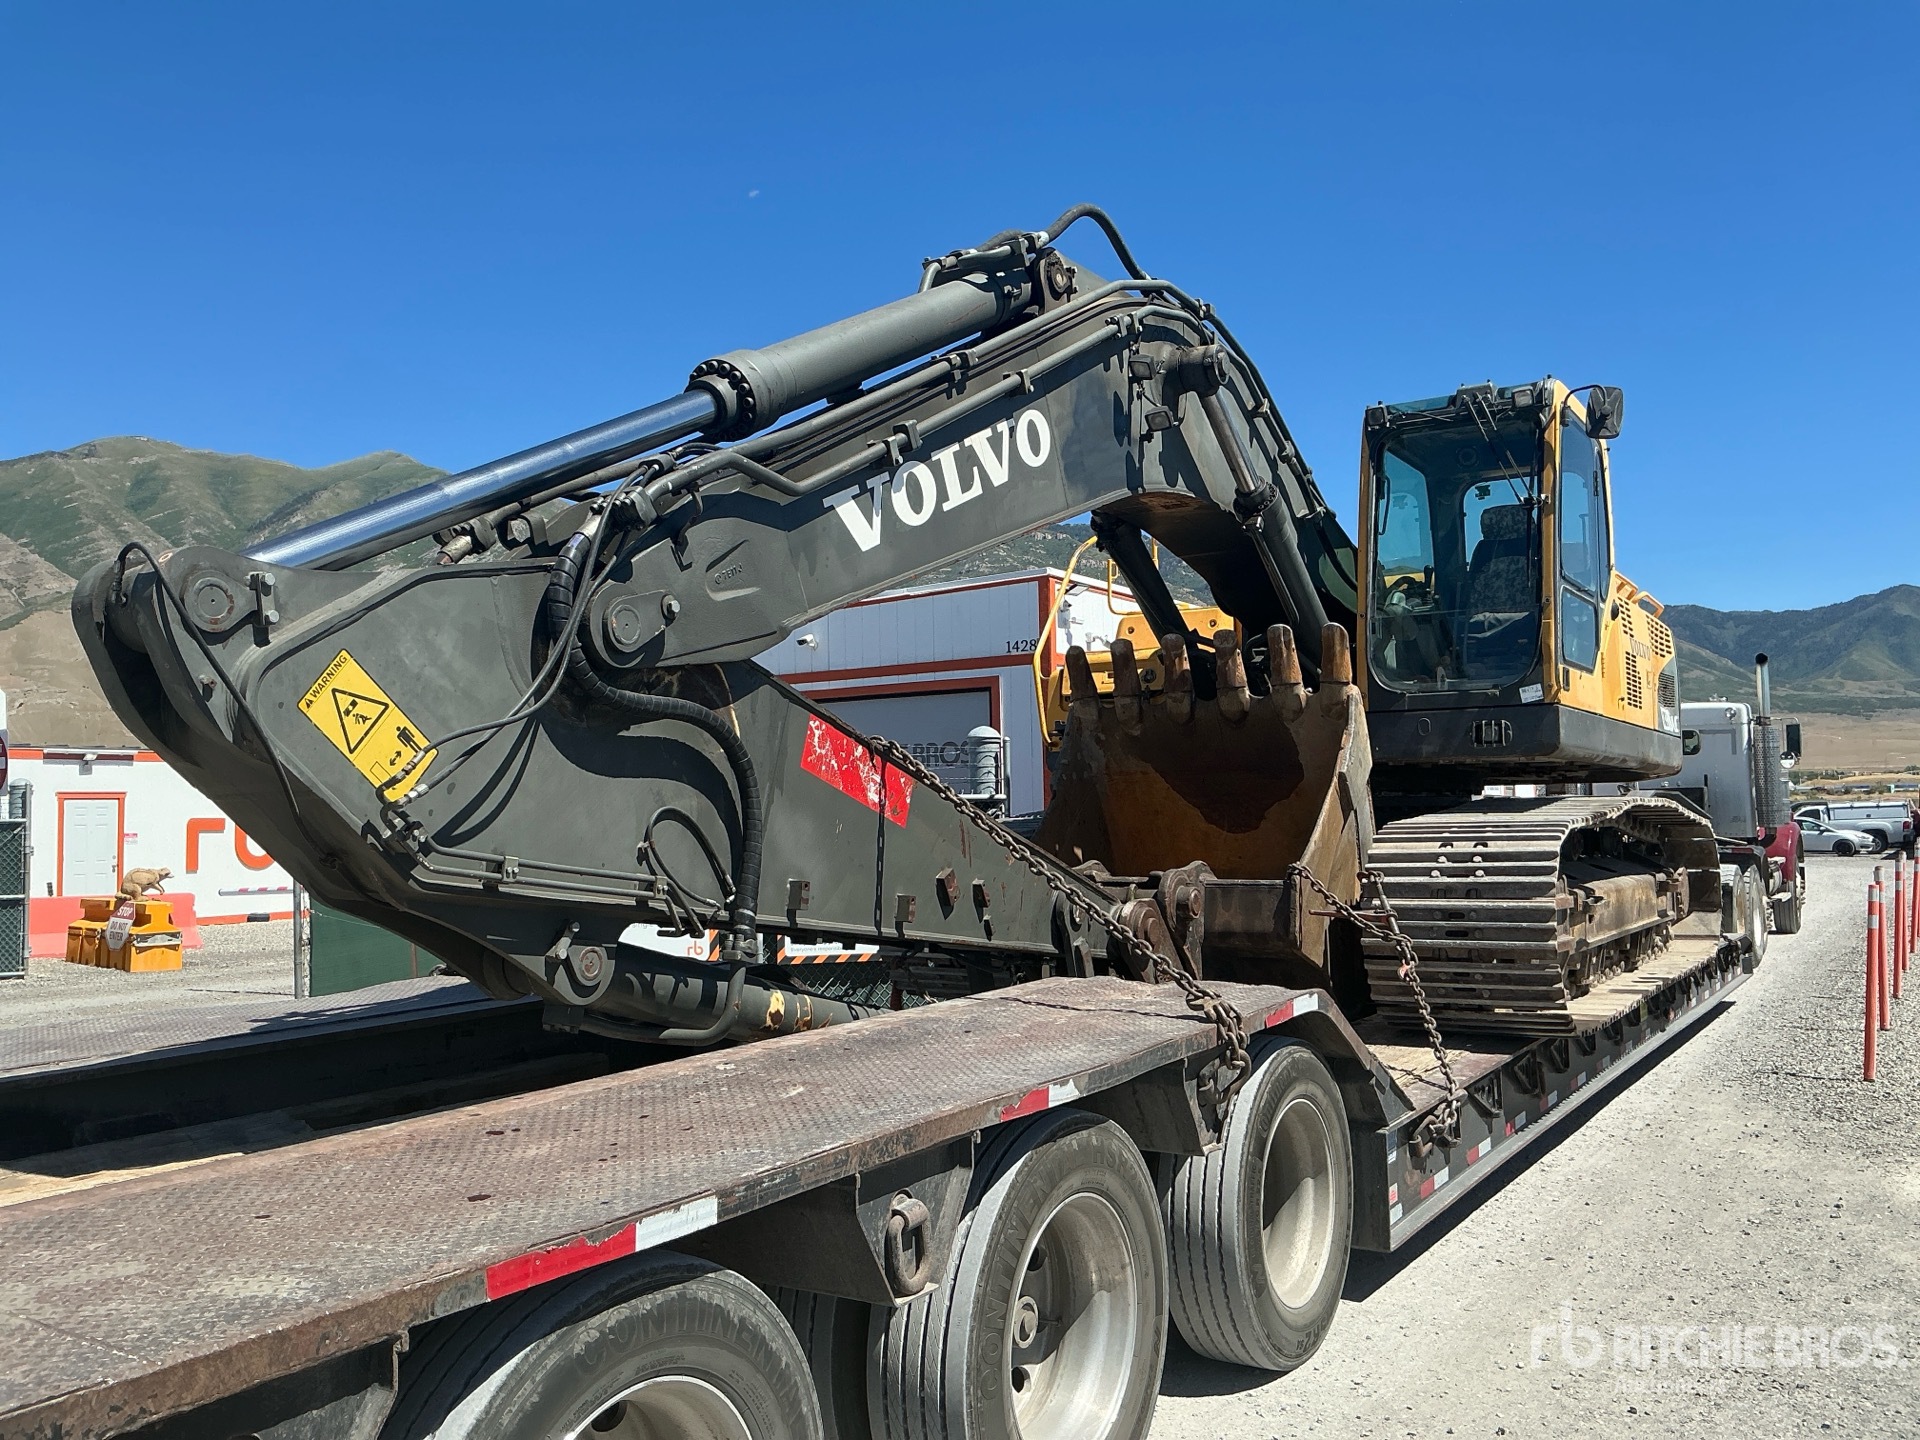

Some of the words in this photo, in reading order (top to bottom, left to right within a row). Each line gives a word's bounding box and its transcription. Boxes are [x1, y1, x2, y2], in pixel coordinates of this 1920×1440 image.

[823, 409, 1050, 552] VOLVO
[1006, 638, 1040, 653] 1428
[310, 654, 348, 698] WARNING
[117, 906, 133, 917] STOP
[110, 921, 118, 930] DO
[118, 922, 128, 931] NOT
[109, 931, 123, 941] ENTER
[687, 940, 704, 956] rb
